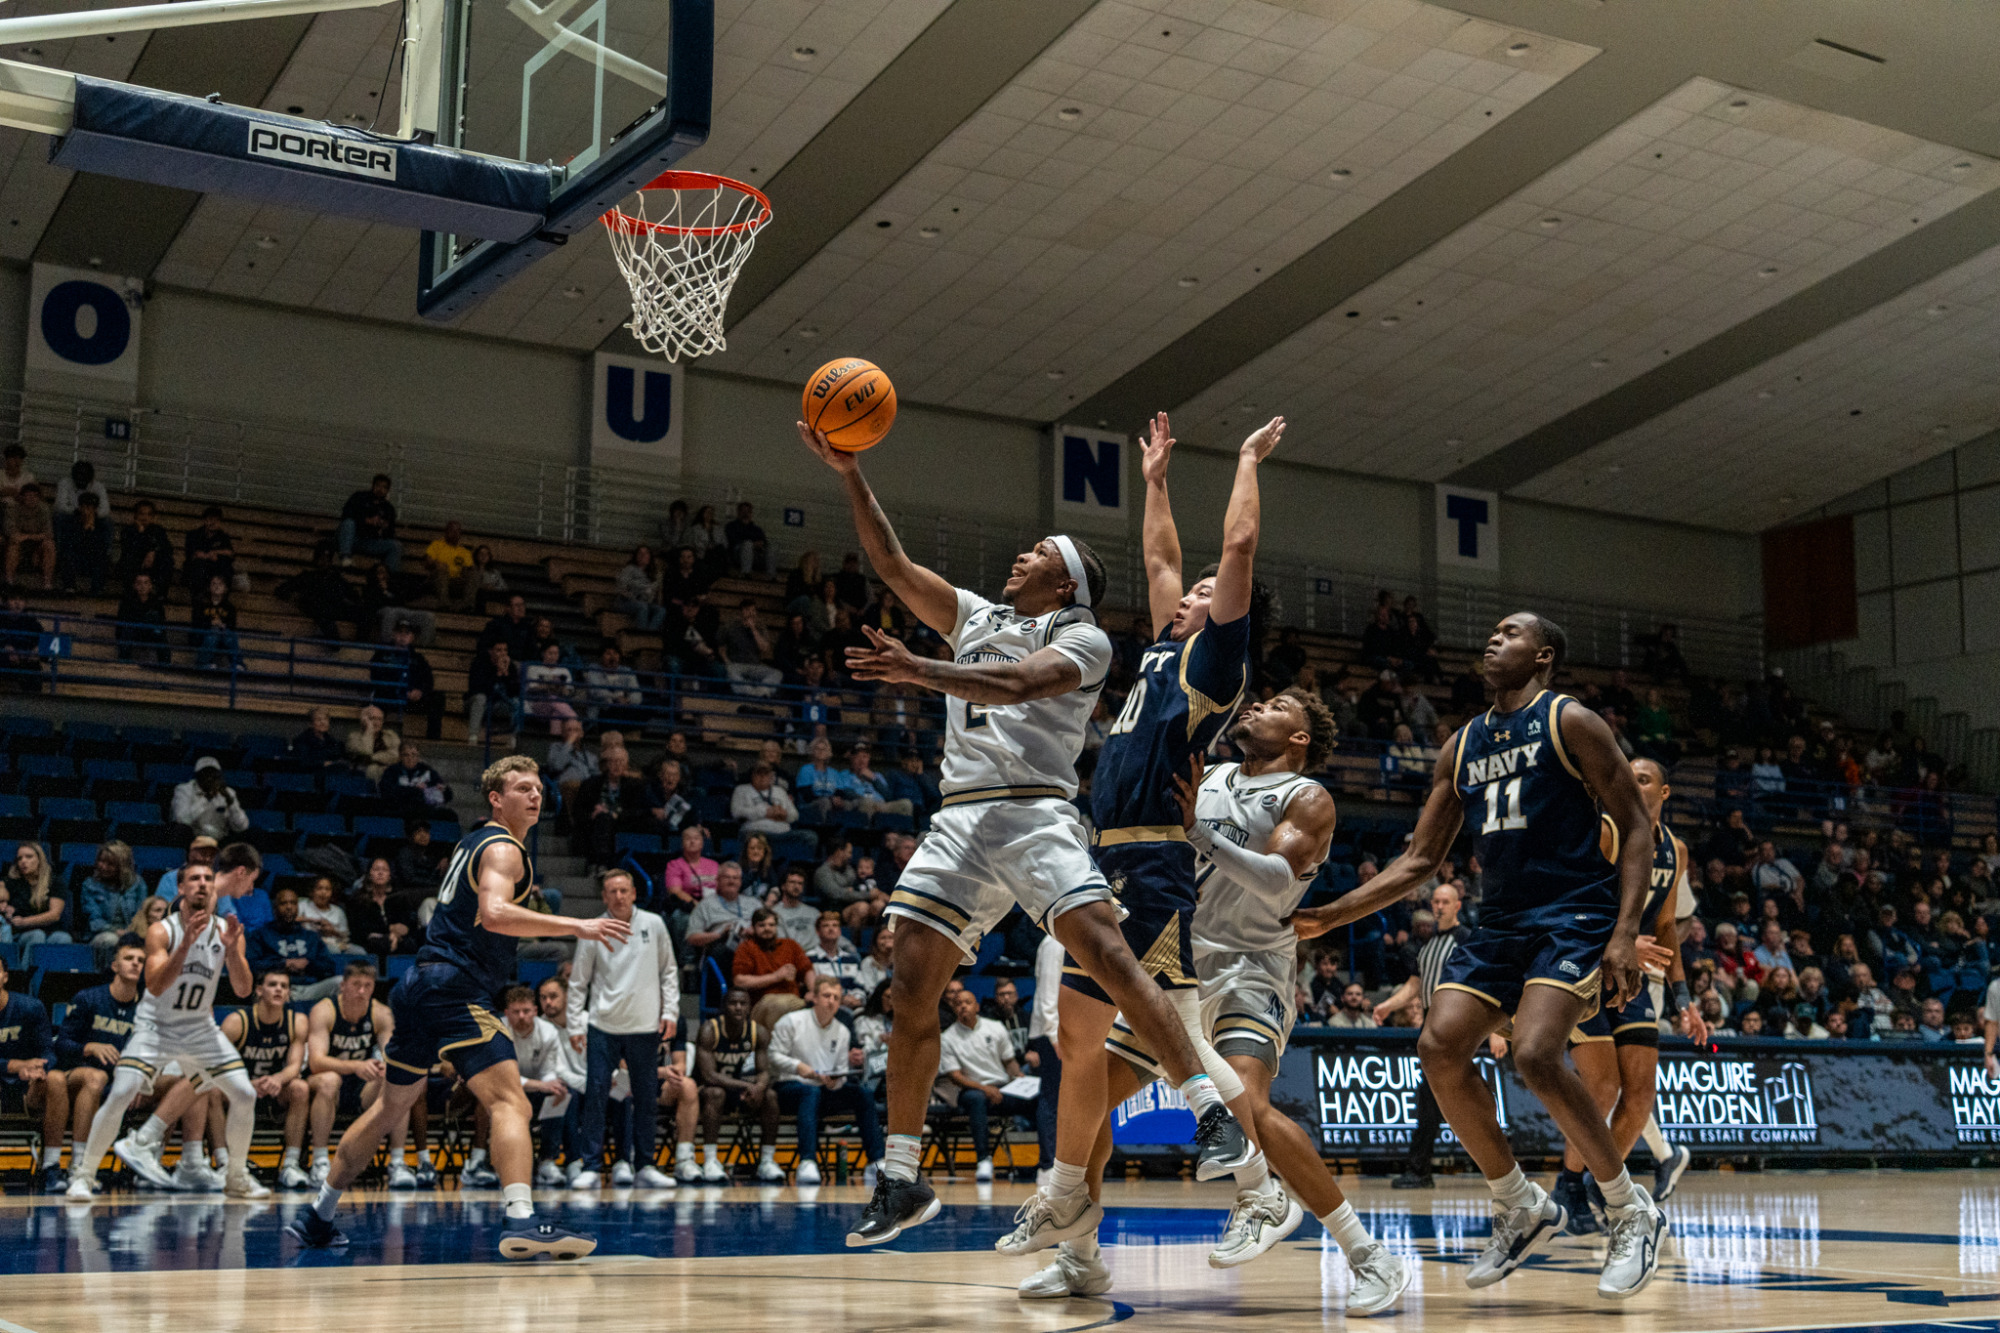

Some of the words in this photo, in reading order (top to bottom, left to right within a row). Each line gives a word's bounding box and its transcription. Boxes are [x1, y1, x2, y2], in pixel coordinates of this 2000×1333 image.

[41, 280, 131, 366] O
[606, 365, 672, 443] U
[844, 381, 875, 412] EVO
[1063, 435, 1119, 508] N
[1447, 495, 1488, 559] T
[49, 636, 60, 655] 4
[1139, 650, 1176, 673] VY
[809, 705, 820, 722] 6
[964, 701, 990, 732] 2
[1466, 740, 1542, 787] NAVY
[1481, 776, 1528, 836] 11
[1650, 868, 1674, 888] VY
[173, 982, 207, 1011] 10
[243, 1045, 288, 1061] NAVY
[333, 1033, 372, 1050] NAVY
[1317, 1055, 1423, 1090] MAGUIR
[1655, 1060, 1759, 1093] MAGUIRE
[1318, 1091, 1420, 1125] HAYDE
[1656, 1093, 1763, 1125] HAYDEN
[1323, 1129, 1362, 1145] REAL
[1368, 1129, 1413, 1145] ESTAT
[1661, 1128, 1695, 1144] REAL
[1700, 1128, 1745, 1144] ESTATE
[1750, 1128, 1818, 1144] COMPANY
